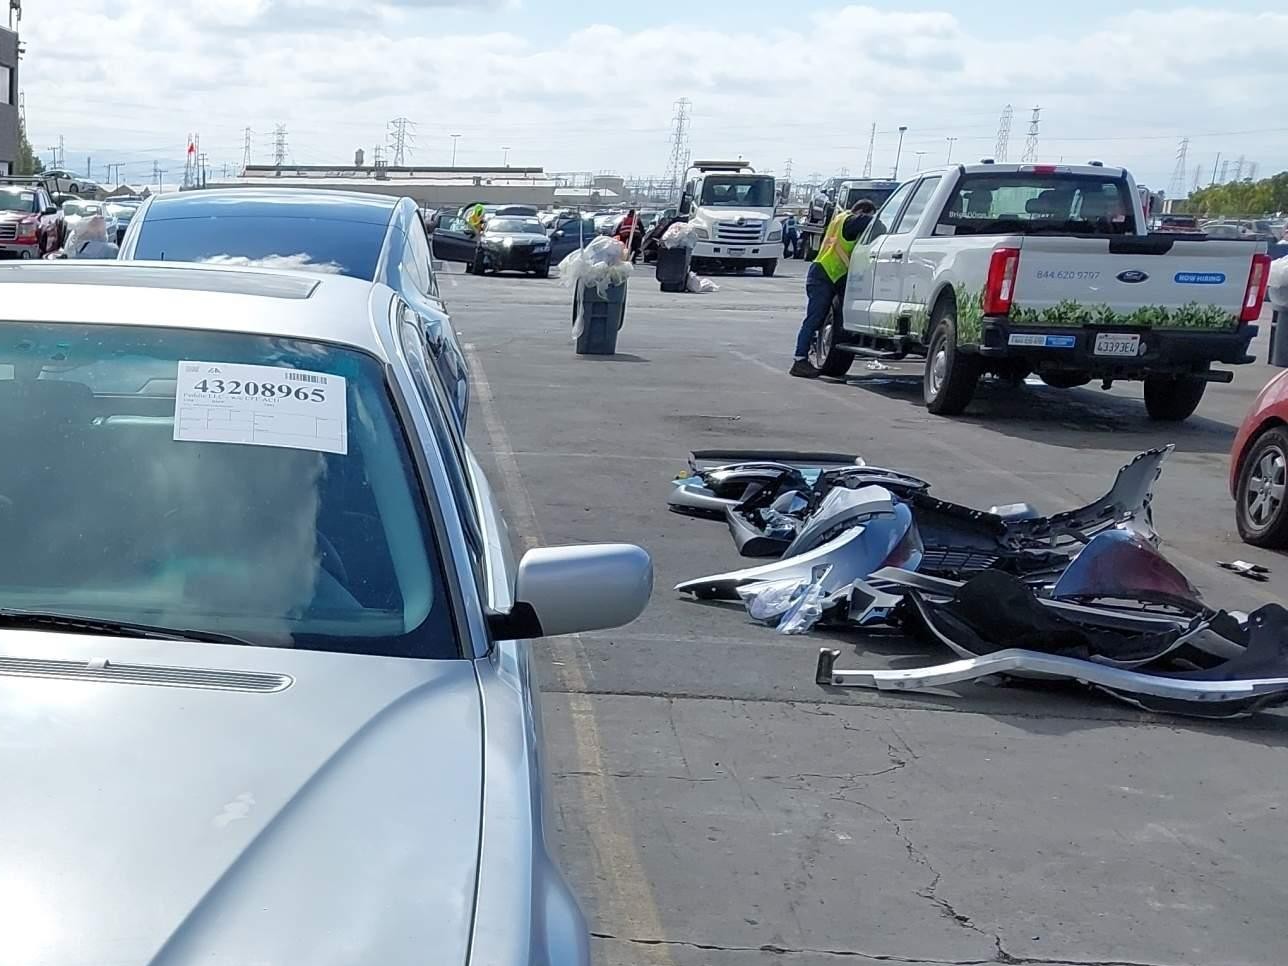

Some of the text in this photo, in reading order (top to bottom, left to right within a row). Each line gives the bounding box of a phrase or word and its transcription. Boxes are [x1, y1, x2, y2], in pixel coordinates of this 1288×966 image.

[1036, 270, 1101, 280] 844 620 9797
[1123, 269, 1144, 281] Ford
[1197, 274, 1222, 282] HIRING
[1097, 341, 1136, 353] 43393E4
[194, 379, 326, 403] 43208965
